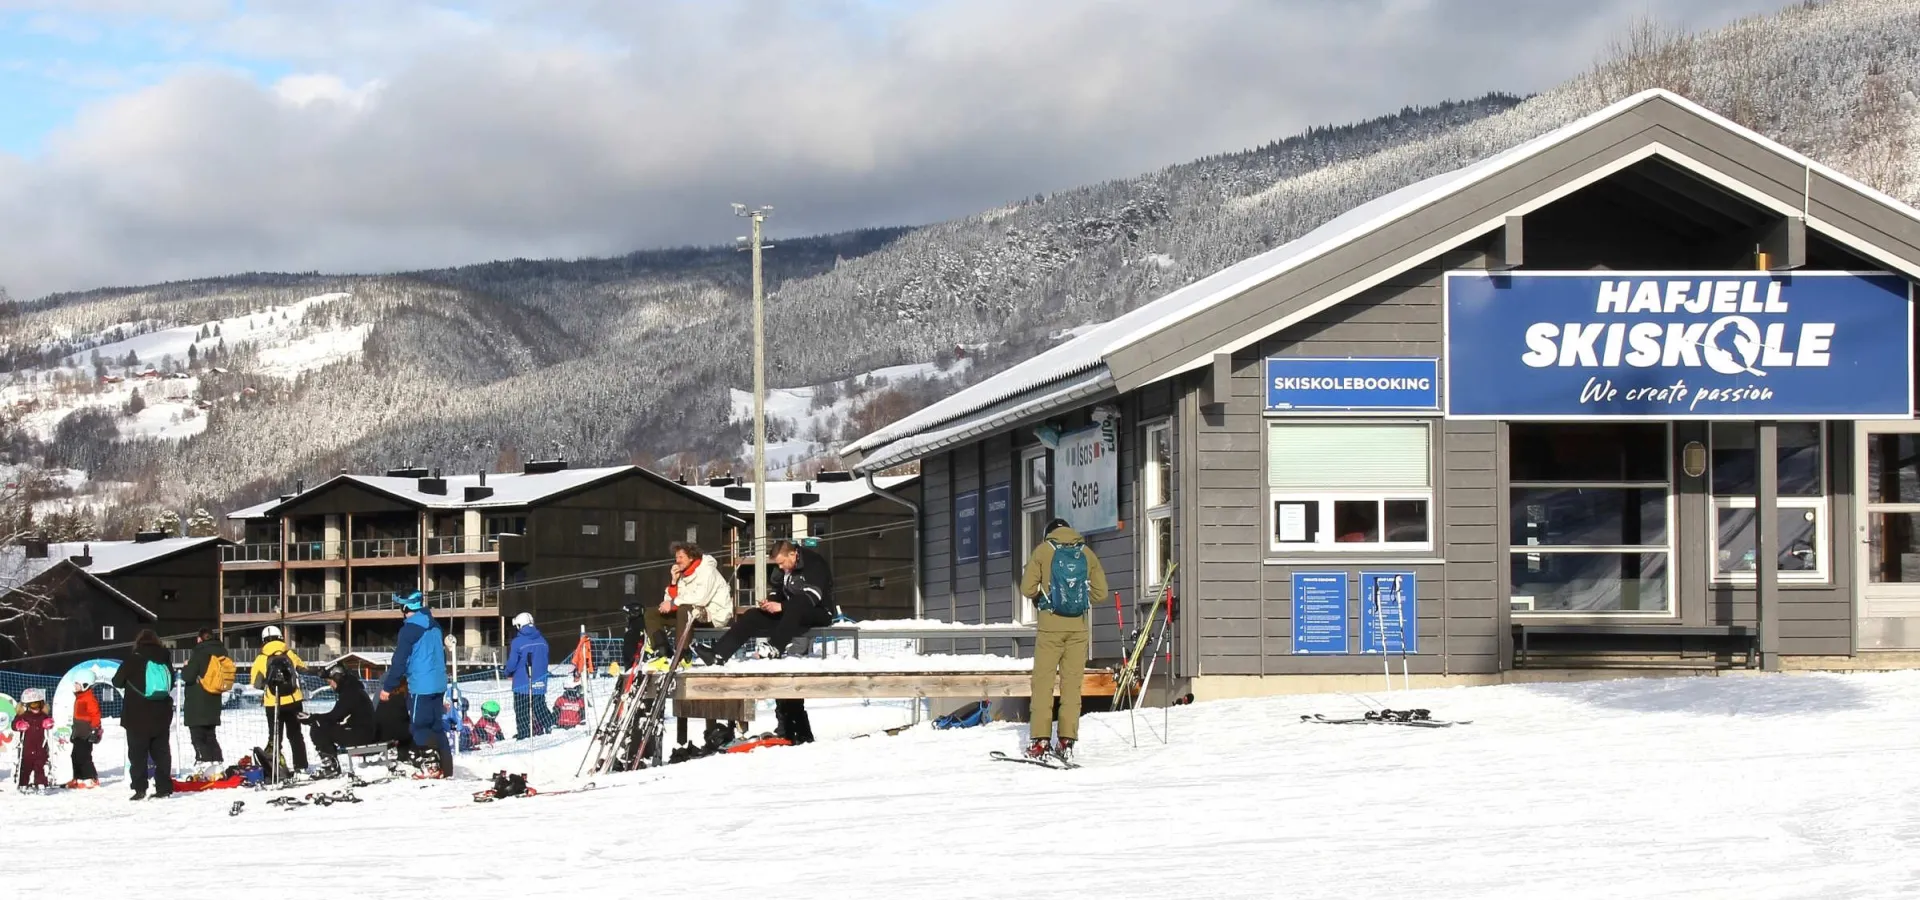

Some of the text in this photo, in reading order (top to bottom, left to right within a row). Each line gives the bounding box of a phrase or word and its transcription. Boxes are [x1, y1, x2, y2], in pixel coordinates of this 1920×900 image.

[1596, 281, 1789, 314] HAFJELL
[1521, 315, 1836, 375] SKISKOLE
[1274, 377, 1430, 391] SKISKOLEBOOKING
[1580, 377, 1774, 411] We create passion
[1071, 481, 1099, 510] Scene
